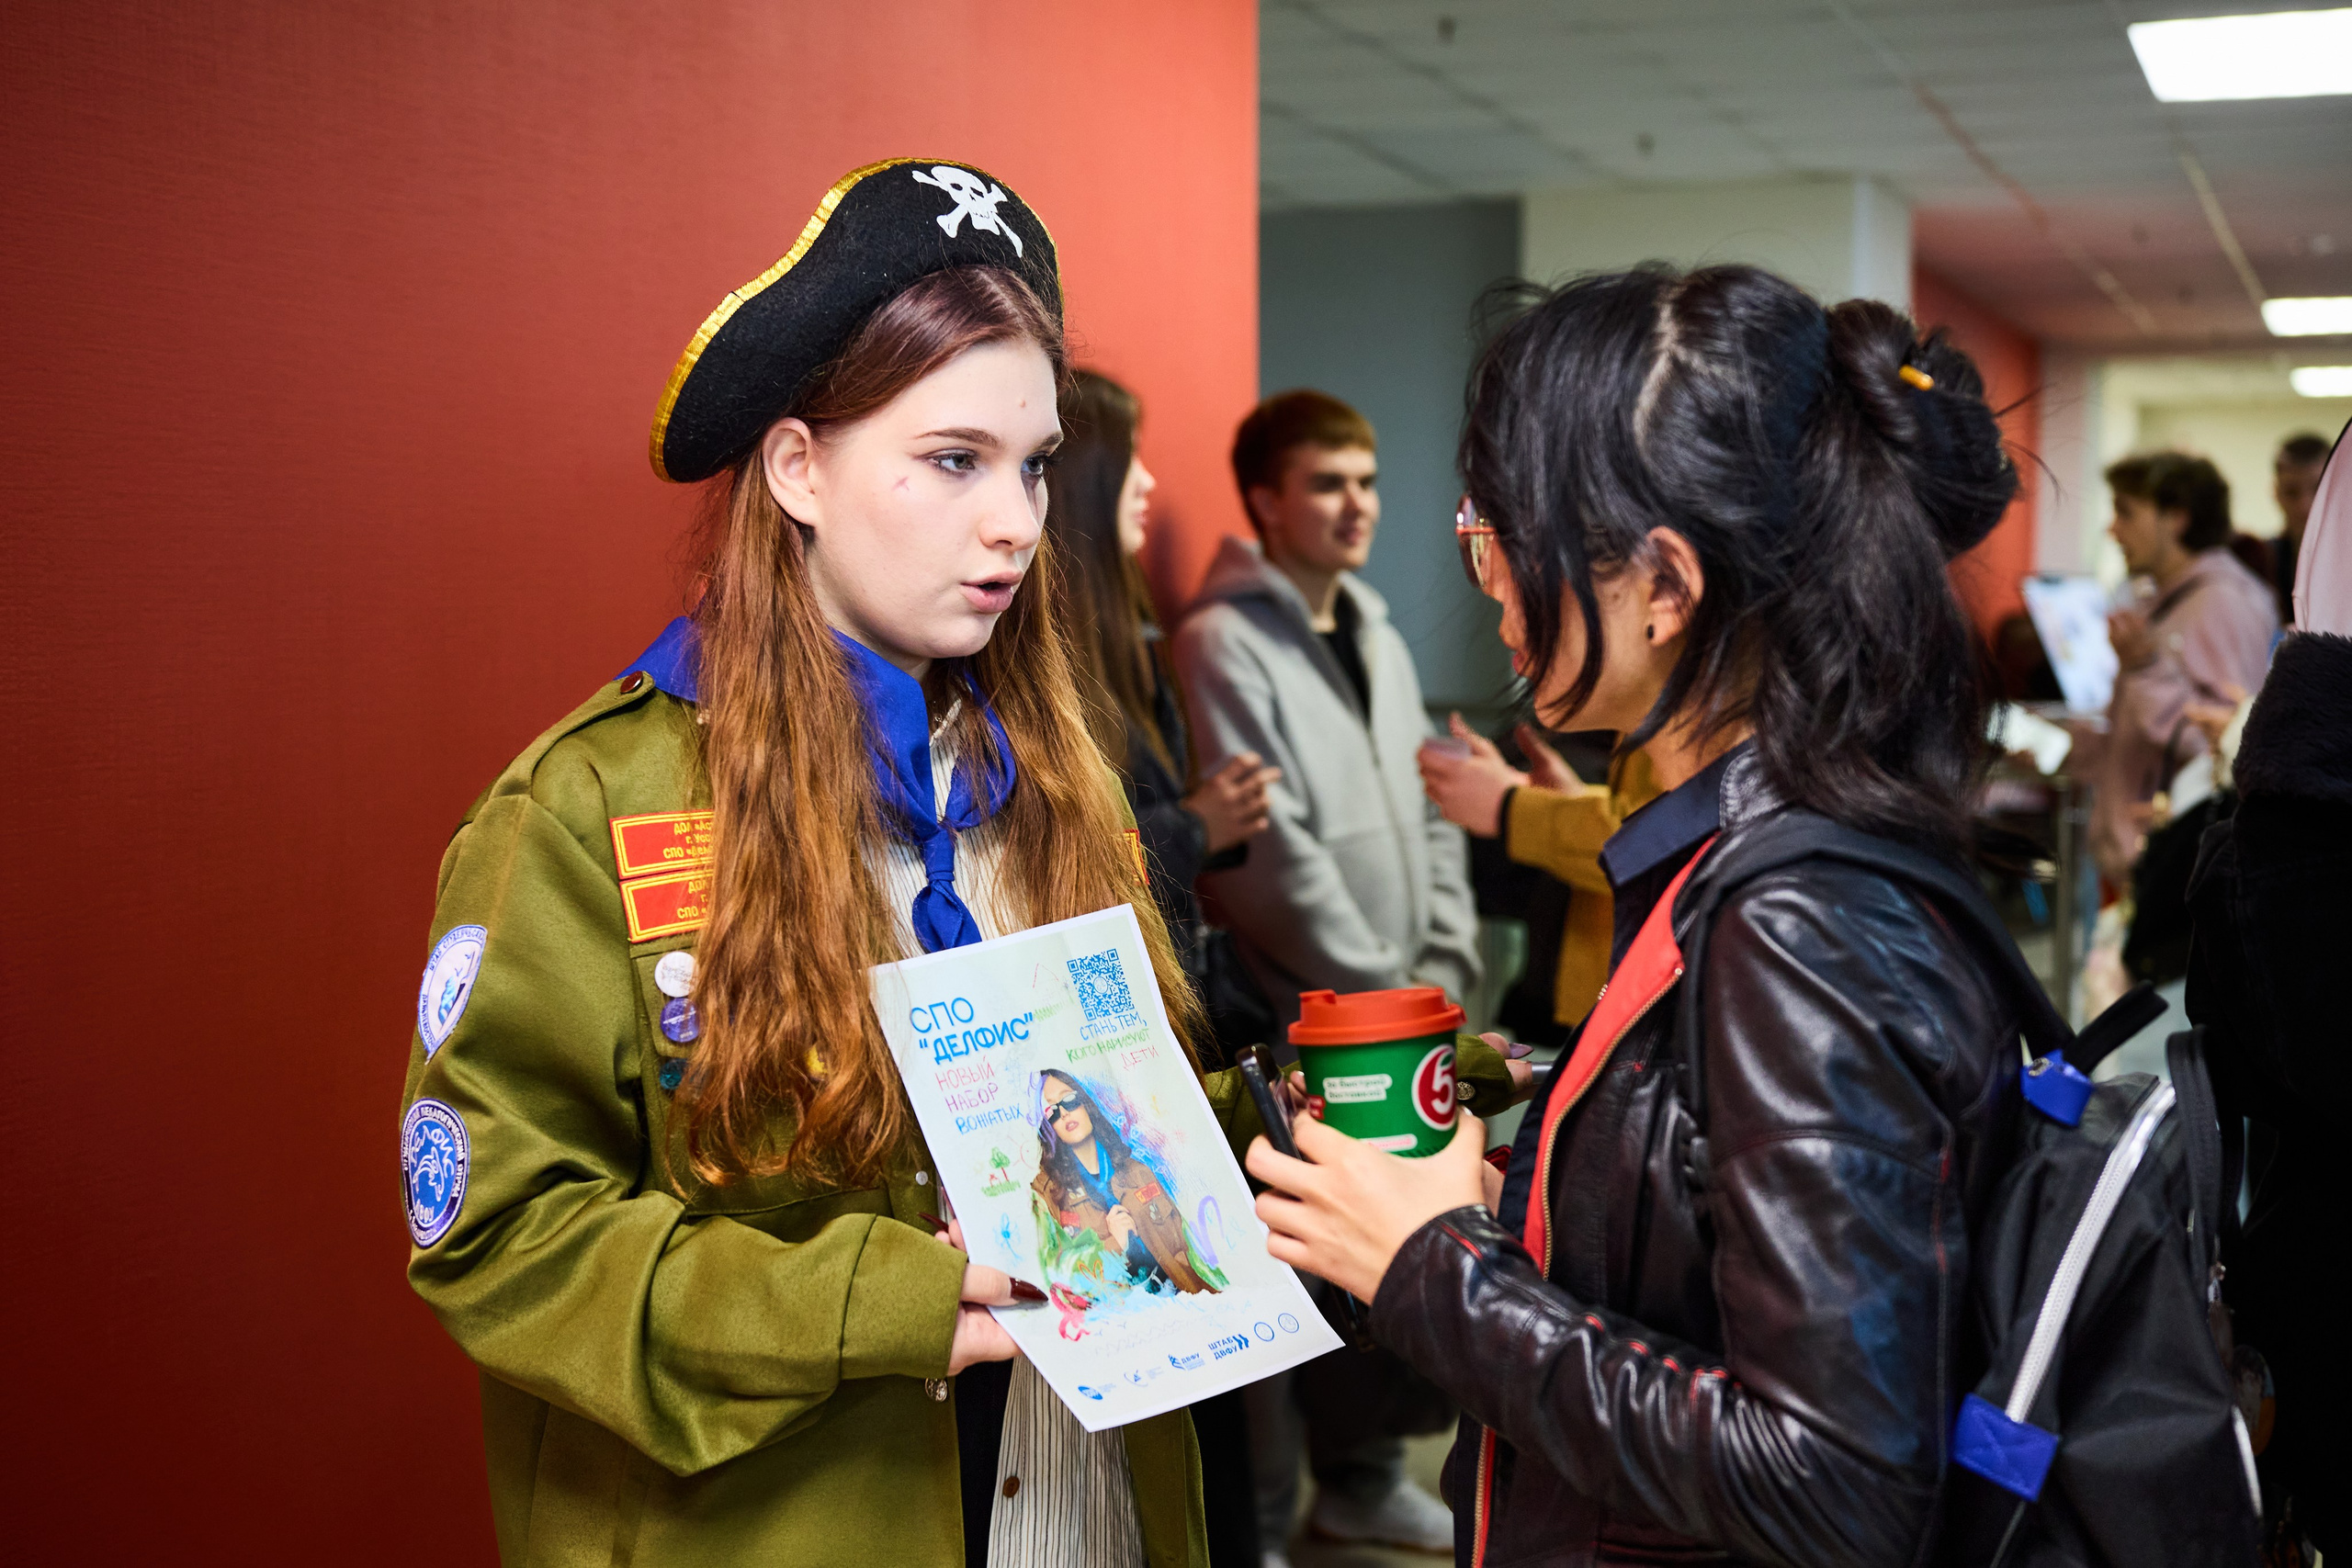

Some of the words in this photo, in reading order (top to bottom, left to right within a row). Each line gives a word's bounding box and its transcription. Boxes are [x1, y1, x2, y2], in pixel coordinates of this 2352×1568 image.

[674, 821, 693, 836] ДОЛ
[662, 846, 684, 859] СПО
[676, 905, 698, 919] СПО
[910, 997, 974, 1033] СПО
[1080, 1018, 1117, 1041] СТАНЬ
[1114, 1010, 1148, 1030] ТЕМ,
[1066, 1043, 1097, 1064] КОГО
[1096, 1028, 1150, 1055] НАРИСУЮТ
[1121, 1044, 1159, 1072] ДЕТИ
[934, 1055, 995, 1092] НОВЫЙ
[944, 1082, 999, 1113] НАБОР
[955, 1102, 1025, 1135] ВОЖАТЫХ
[1208, 1336, 1234, 1350] ШТАБ
[1214, 1345, 1238, 1360] ДВФУ
